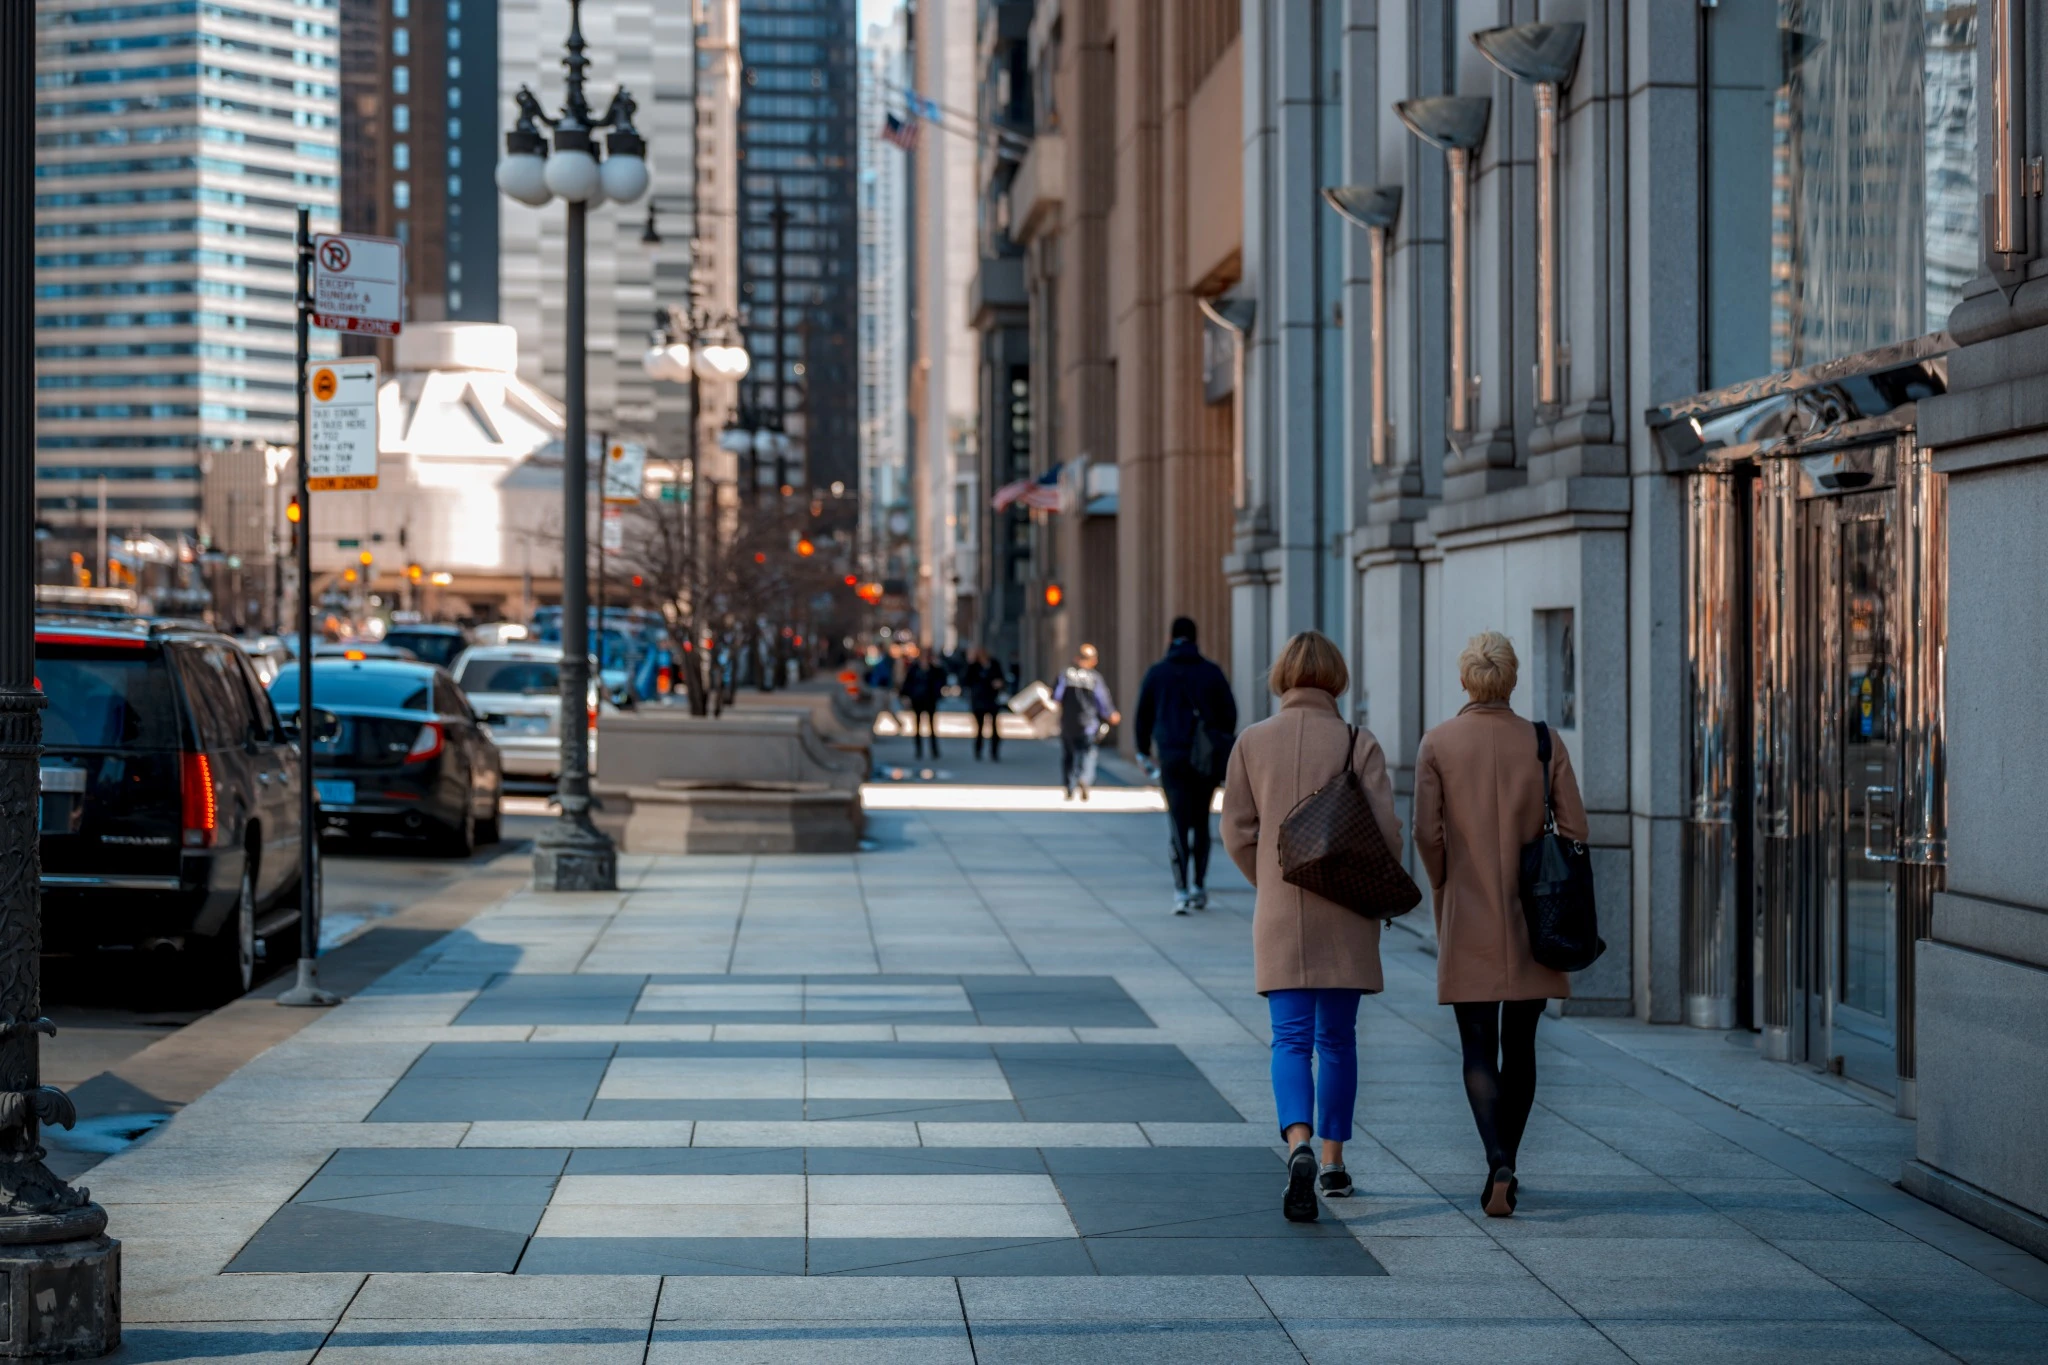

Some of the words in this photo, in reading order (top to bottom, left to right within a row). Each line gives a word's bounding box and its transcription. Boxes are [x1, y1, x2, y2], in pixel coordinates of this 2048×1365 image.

[320, 279, 355, 289] EXCEPT
[320, 290, 358, 300] SUNDAY
[363, 293, 371, 303] &
[319, 301, 366, 313] HOLIDAYS
[319, 315, 348, 329] TOW
[357, 318, 391, 333] ZONE
[313, 478, 336, 489] TOW
[343, 477, 373, 488] ZONE
